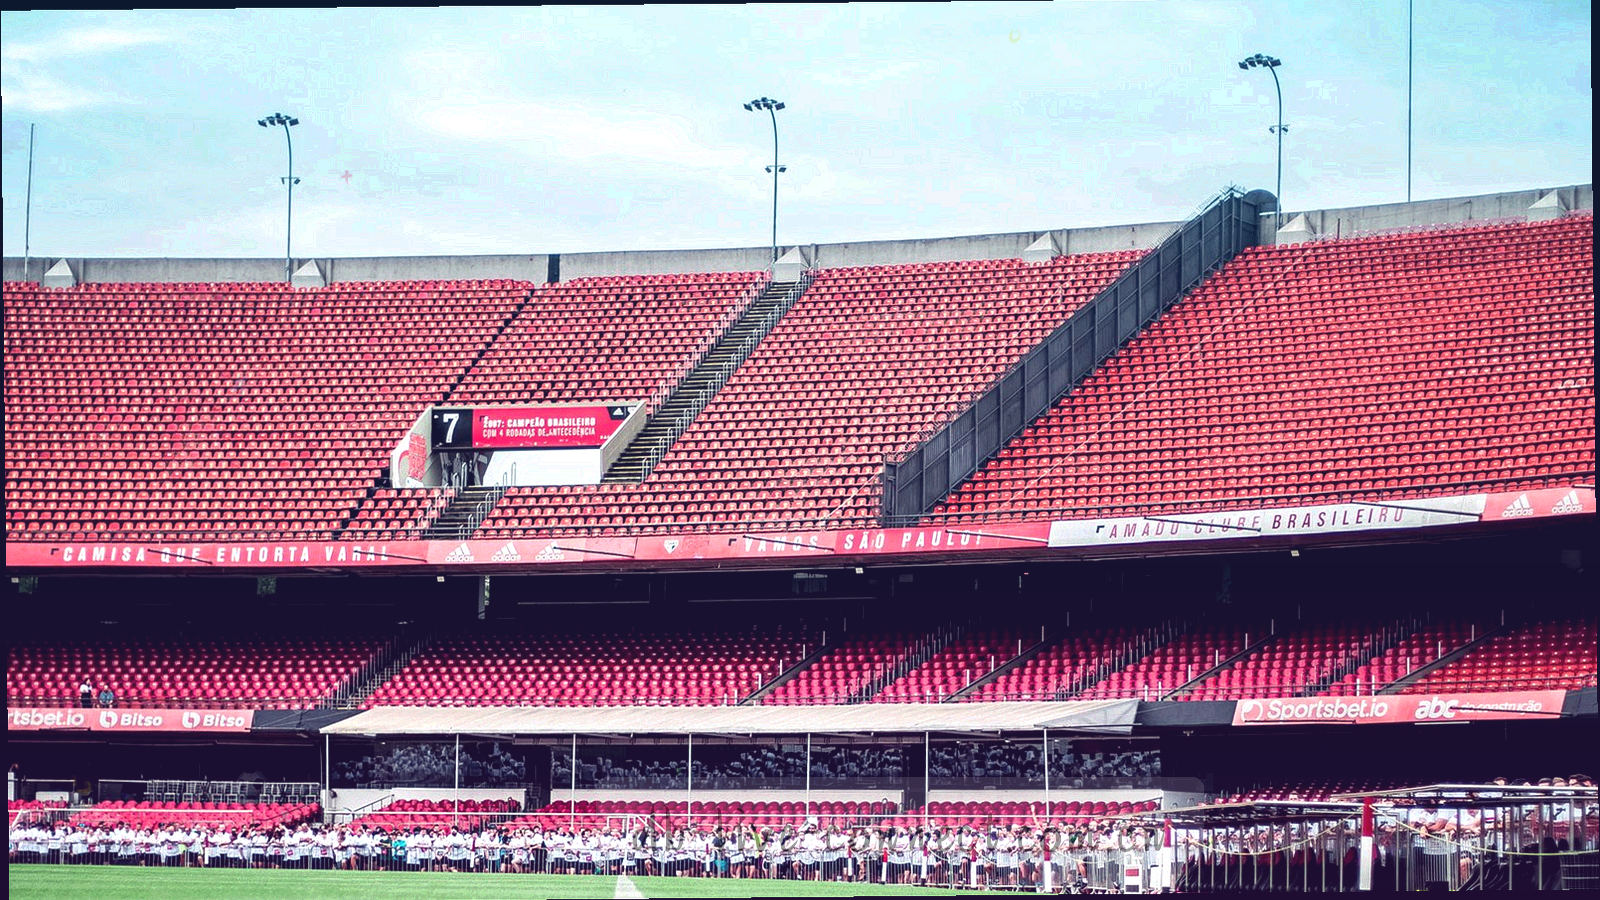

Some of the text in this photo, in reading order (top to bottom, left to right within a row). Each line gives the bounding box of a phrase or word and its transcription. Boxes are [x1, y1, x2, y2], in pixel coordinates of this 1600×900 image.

[443, 413, 459, 443] 7
[482, 429, 497, 438] COM
[506, 429, 535, 438] RODADAS
[1109, 506, 1404, 539] AMADO CLUBE BRASILEIRO
[844, 531, 885, 549] SÃO
[901, 529, 983, 548] PAULO!
[63, 546, 389, 563] CAMISA QUE ENTORTA VARAL
[1267, 699, 1388, 720] Sportsbet.io
[1414, 696, 1459, 719] abc
[120, 711, 163, 727] Bitso
[203, 711, 245, 727] Bitso
